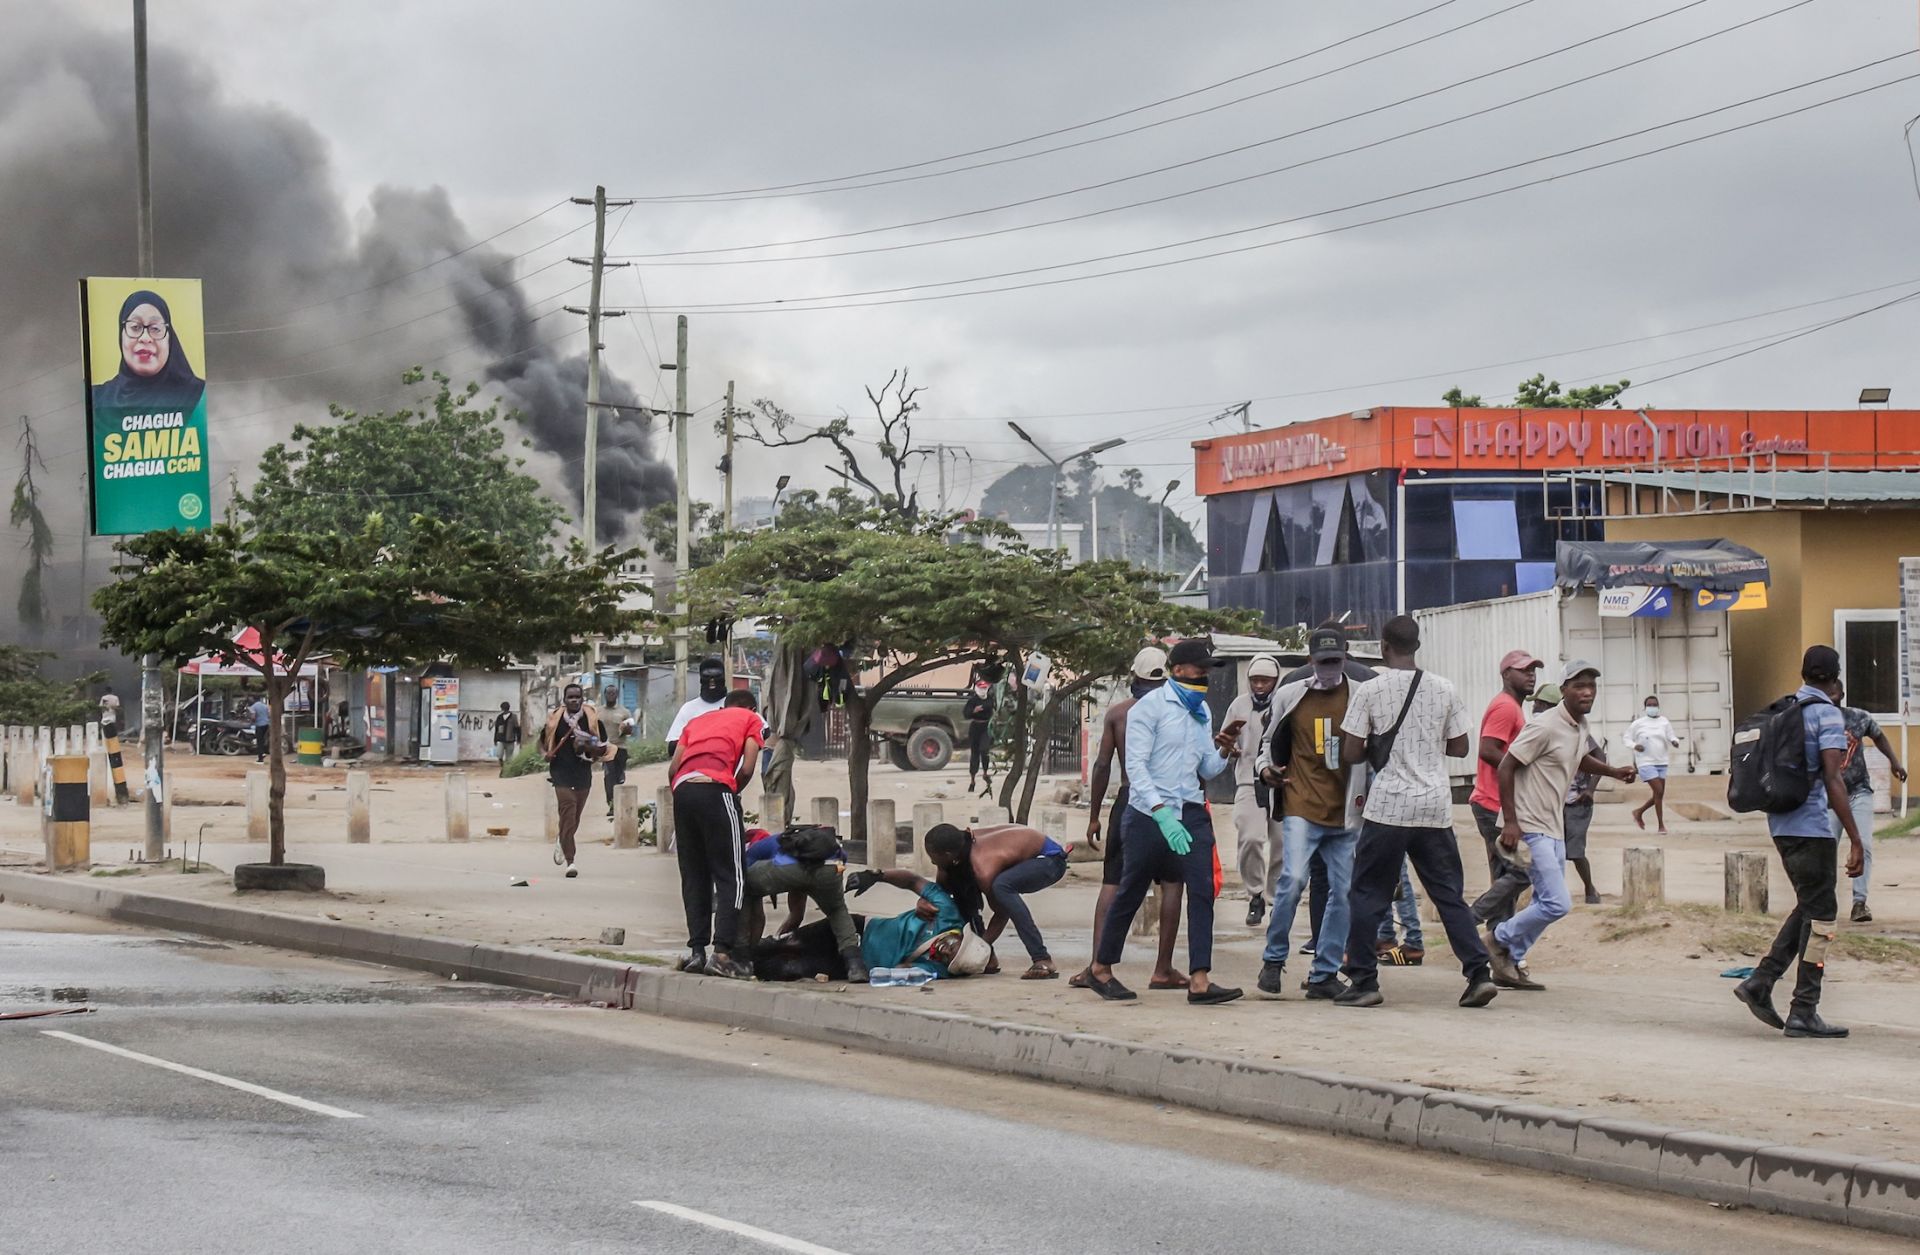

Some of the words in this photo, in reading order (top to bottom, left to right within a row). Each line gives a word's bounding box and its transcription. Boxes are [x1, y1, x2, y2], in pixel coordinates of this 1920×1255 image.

[122, 411, 184, 431] CHAGUA
[103, 427, 200, 463] SAMIA
[1464, 420, 1592, 457] HAPPY
[1602, 422, 1730, 458] NATION
[103, 460, 166, 479] CHAGUA
[167, 457, 201, 474] CCM
[1603, 595, 1630, 605] NMB
